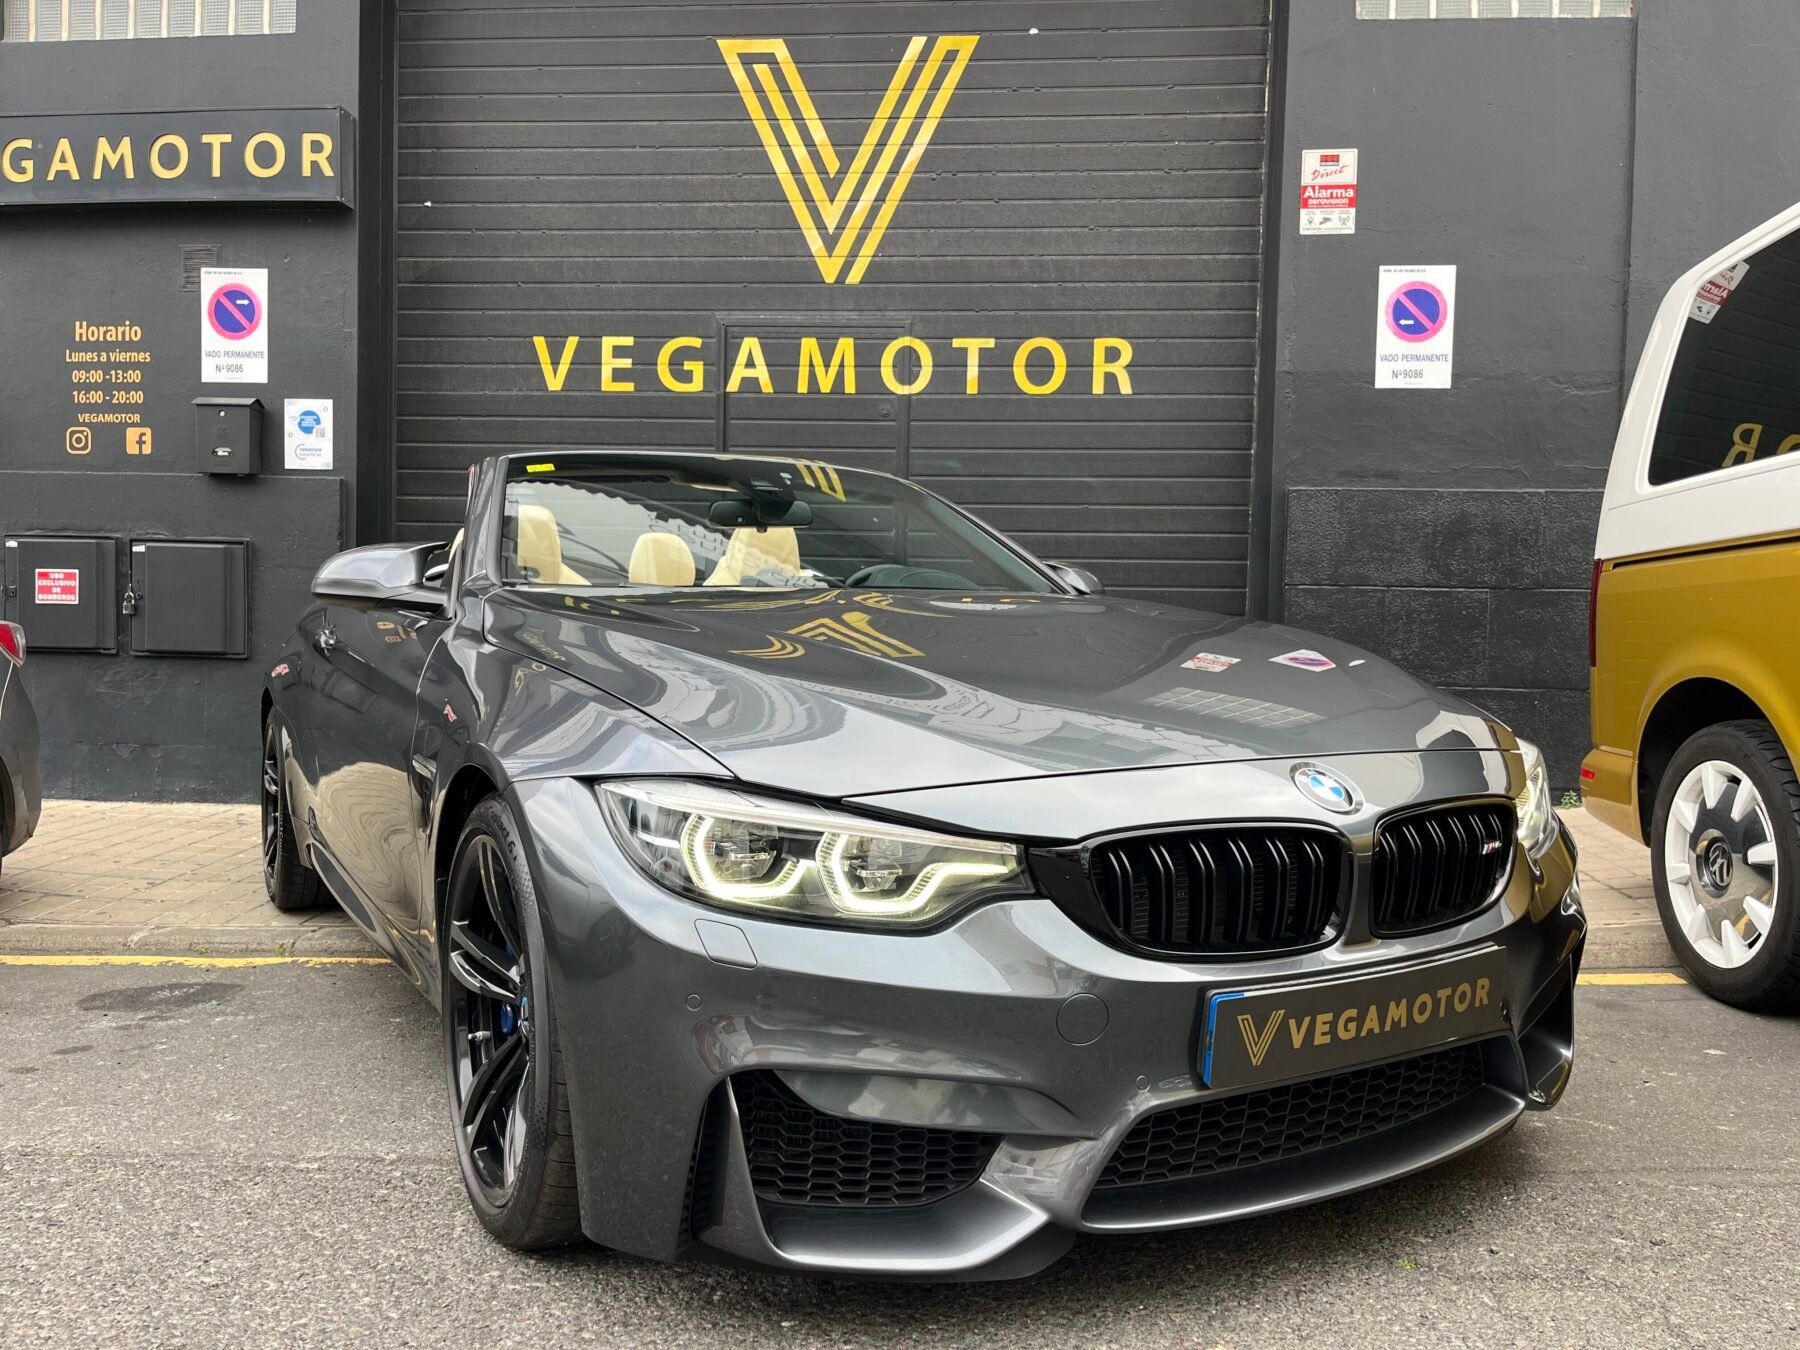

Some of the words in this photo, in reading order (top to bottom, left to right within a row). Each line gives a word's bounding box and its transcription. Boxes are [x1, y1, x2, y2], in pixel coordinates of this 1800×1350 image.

[1, 131, 335, 183] GAMOTOR
[1303, 186, 1354, 198] Alarma
[75, 320, 142, 342] Horario
[65, 349, 99, 362] Lunes
[100, 352, 107, 362] a
[109, 349, 151, 362] viernes
[205, 350, 221, 358] VADO
[223, 351, 265, 359] PERMANENTE
[1379, 354, 1399, 362] VADO
[1401, 354, 1449, 362] PERMANENTE
[532, 335, 1135, 396] VEGAMOTOR
[72, 370, 103, 383] 09:00
[72, 391, 104, 404] 16:00
[111, 391, 144, 404] 20:00
[78, 413, 141, 423] VEGAMOTOR
[1288, 977, 1491, 1050] VEGAMOTOR
